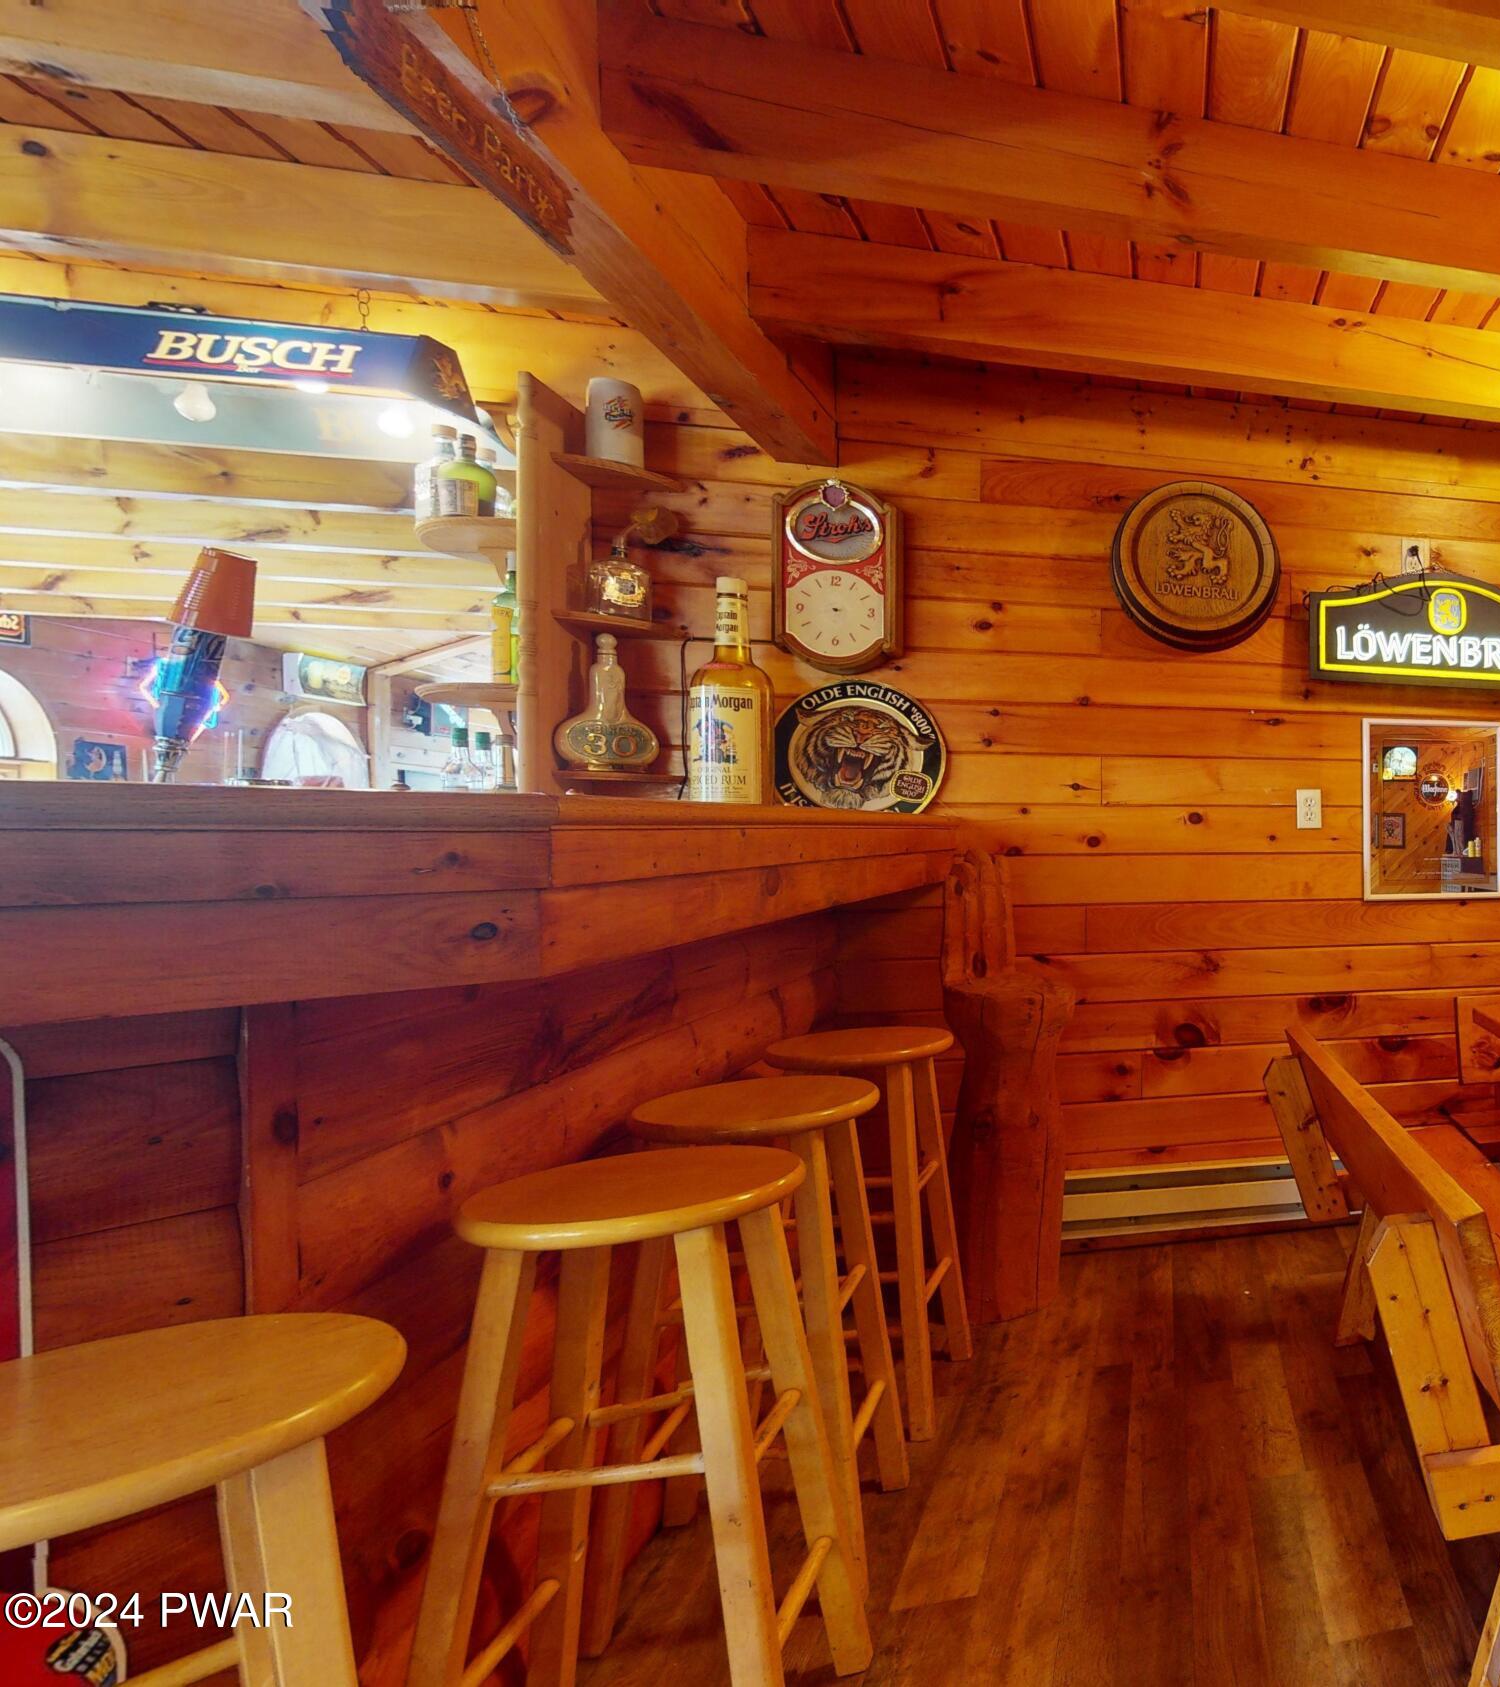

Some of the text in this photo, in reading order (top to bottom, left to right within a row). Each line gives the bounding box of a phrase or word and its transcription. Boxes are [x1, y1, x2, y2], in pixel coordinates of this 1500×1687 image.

[146, 330, 363, 373] BUSCH
[800, 511, 874, 542] Stroh's
[830, 575, 842, 587] 12
[796, 602, 805, 613] 9
[866, 607, 875, 618] 3
[832, 636, 840, 646] 6
[711, 694, 753, 711] Morgan
[801, 686, 843, 710] OLDE
[846, 684, 911, 712] ENGLISH
[721, 775, 746, 786] RUM
